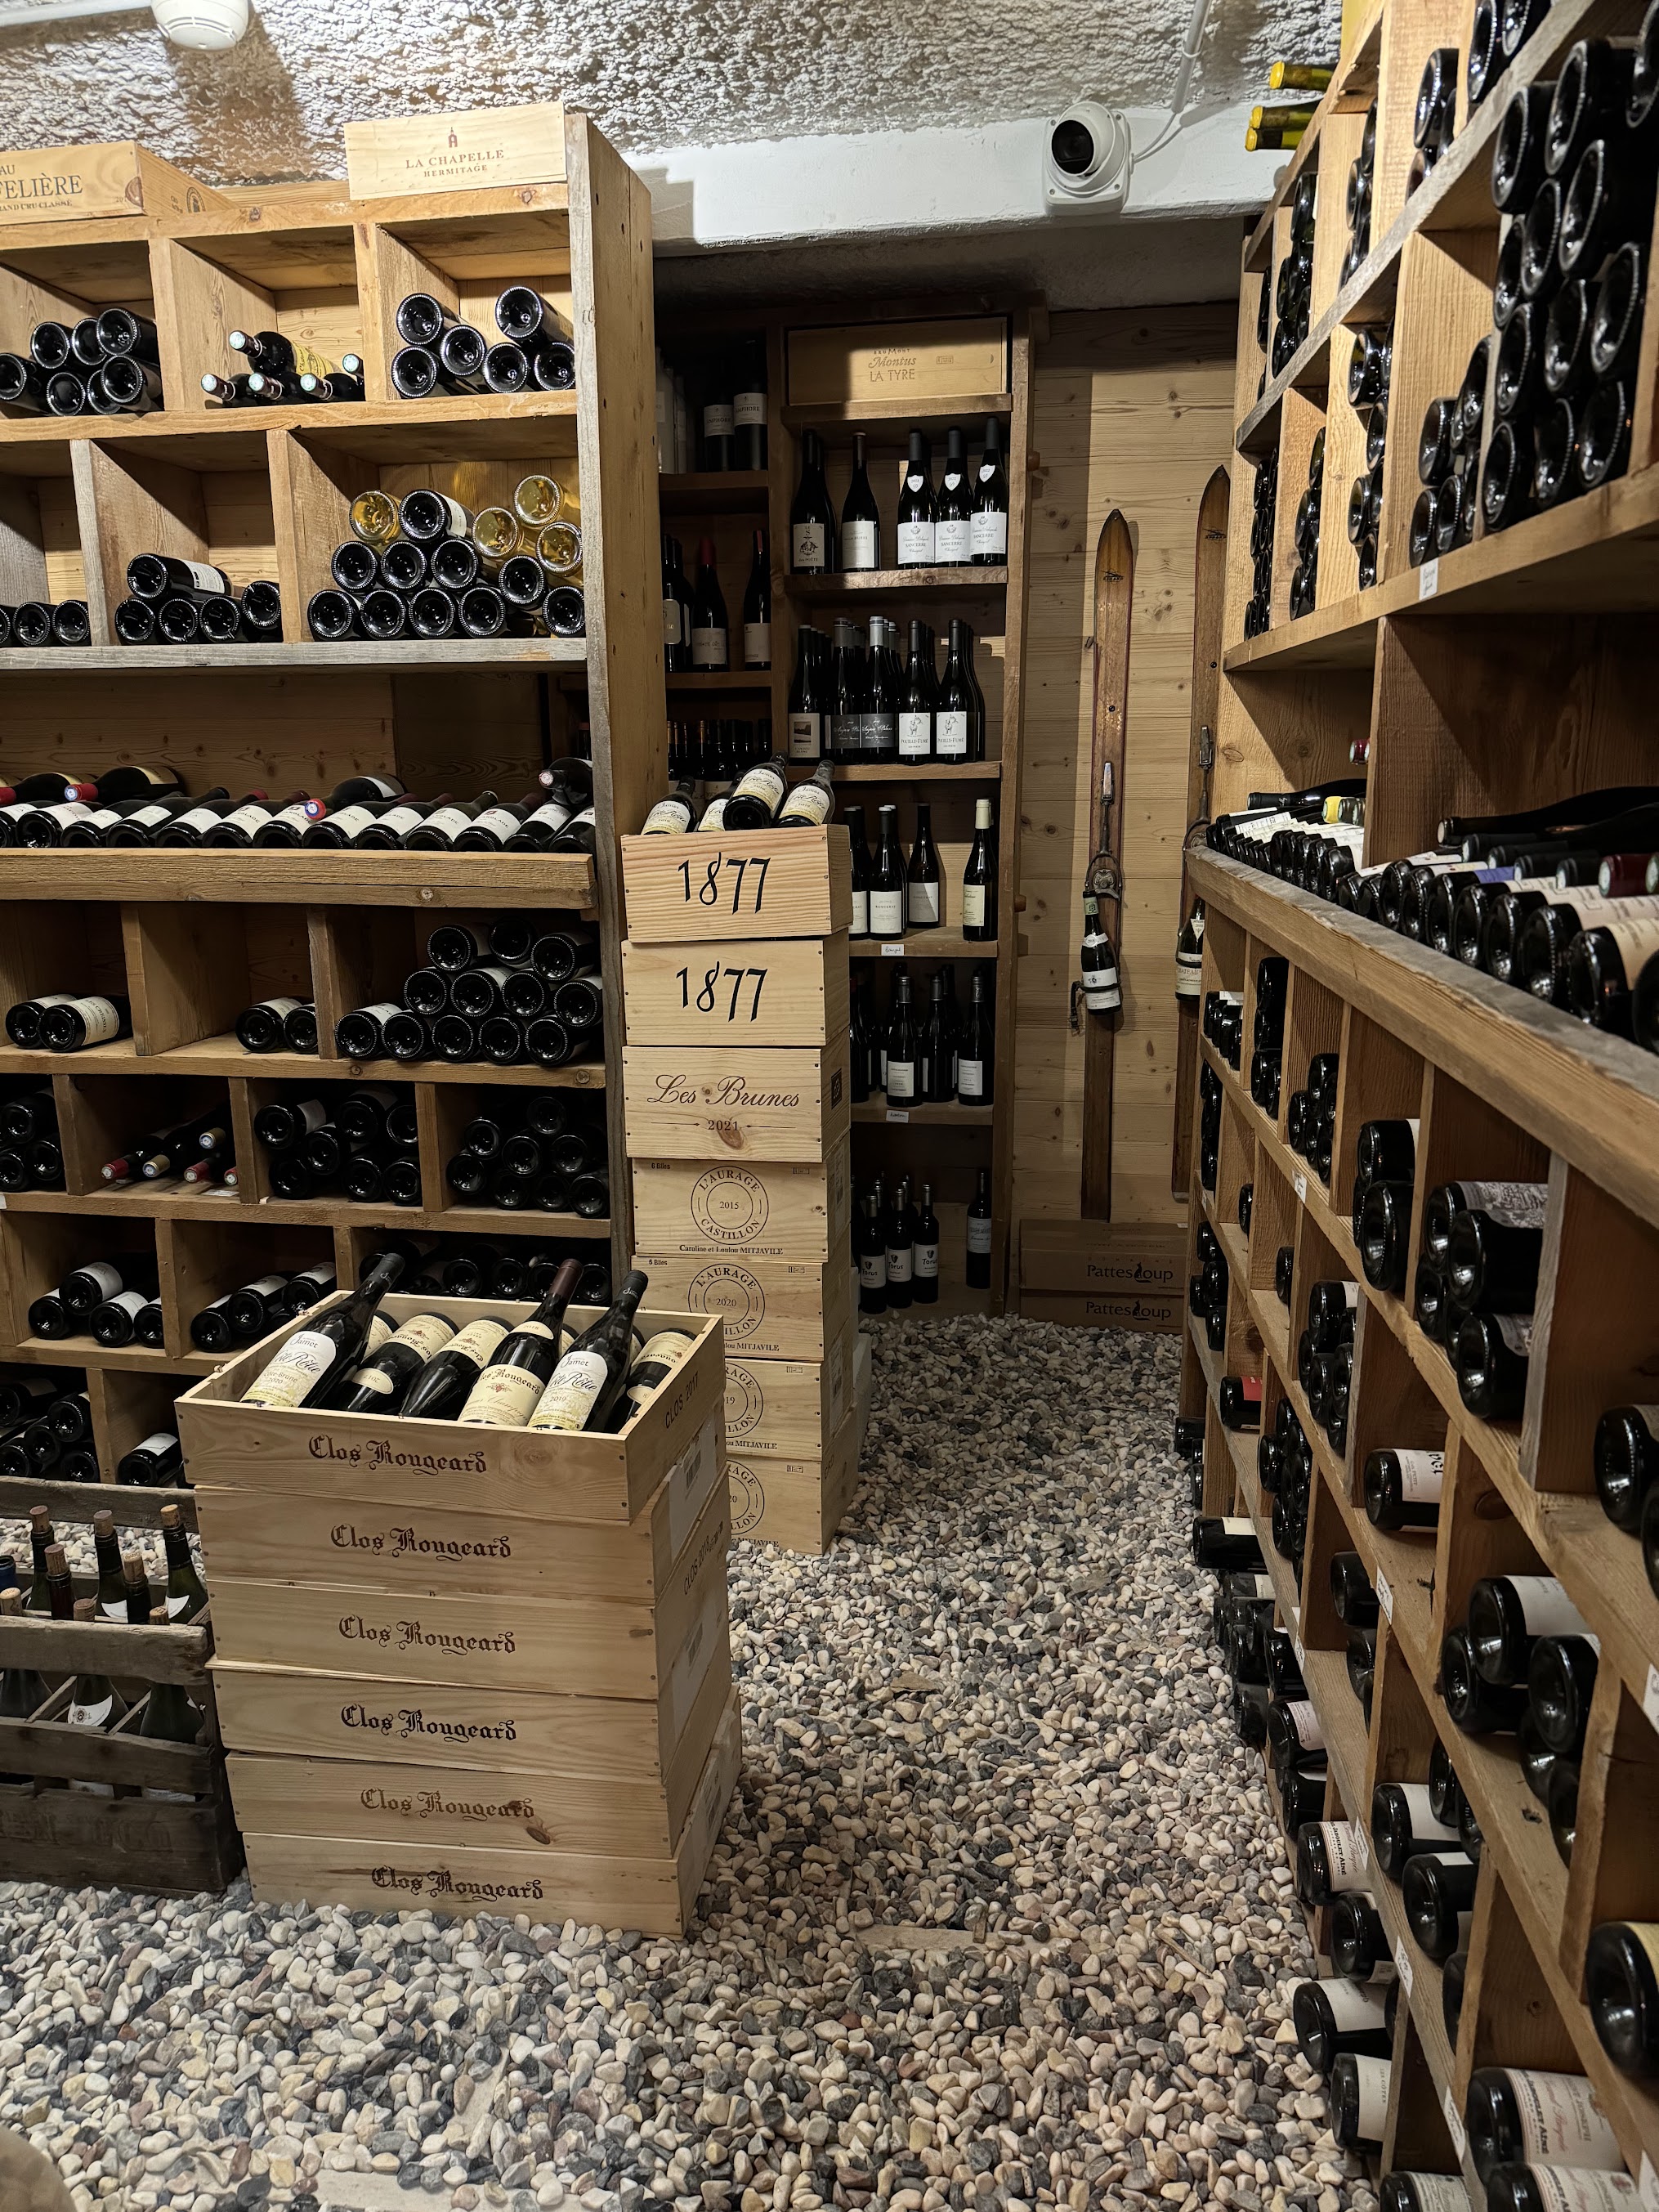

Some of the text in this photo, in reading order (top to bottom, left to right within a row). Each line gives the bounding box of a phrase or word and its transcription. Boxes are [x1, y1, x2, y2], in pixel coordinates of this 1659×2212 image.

[406, 150, 504, 169] LA CHAPELLE
[423, 164, 488, 177] HERMITAGE
[868, 356, 917, 369] Montus
[870, 369, 915, 382] LA TYRE
[677, 852, 771, 915] 1877
[676, 960, 768, 1023] 1877
[646, 1074, 799, 1107] Les Brunes
[708, 1120, 740, 1131] 2021
[699, 1170, 760, 1193] L'AURAGE
[719, 1201, 740, 1210] 2015
[700, 1218, 760, 1240] CASTILLON
[679, 1244, 707, 1253] Caroline
[740, 1247, 784, 1255] MITJAVILE
[695, 1268, 757, 1290] L'AURAGE
[716, 1298, 737, 1306] 2020
[724, 1316, 757, 1336] ILLON
[736, 1343, 780, 1351] MITJAVILE
[561, 1355, 589, 1368] Jamet
[664, 1372, 700, 1429] CLOS 2017
[726, 1396, 736, 1404] 19
[309, 1435, 487, 1475] Clos Rougeard
[736, 1440, 777, 1449] MITJAVILE
[330, 1523, 512, 1561] Clos Rougeard
[339, 1614, 516, 1656] Clos Rougeard
[341, 1704, 516, 1743] Clos Rougeard
[360, 1788, 534, 1821] Clos Rougeard
[372, 1865, 543, 1902] Clos Rougeard
